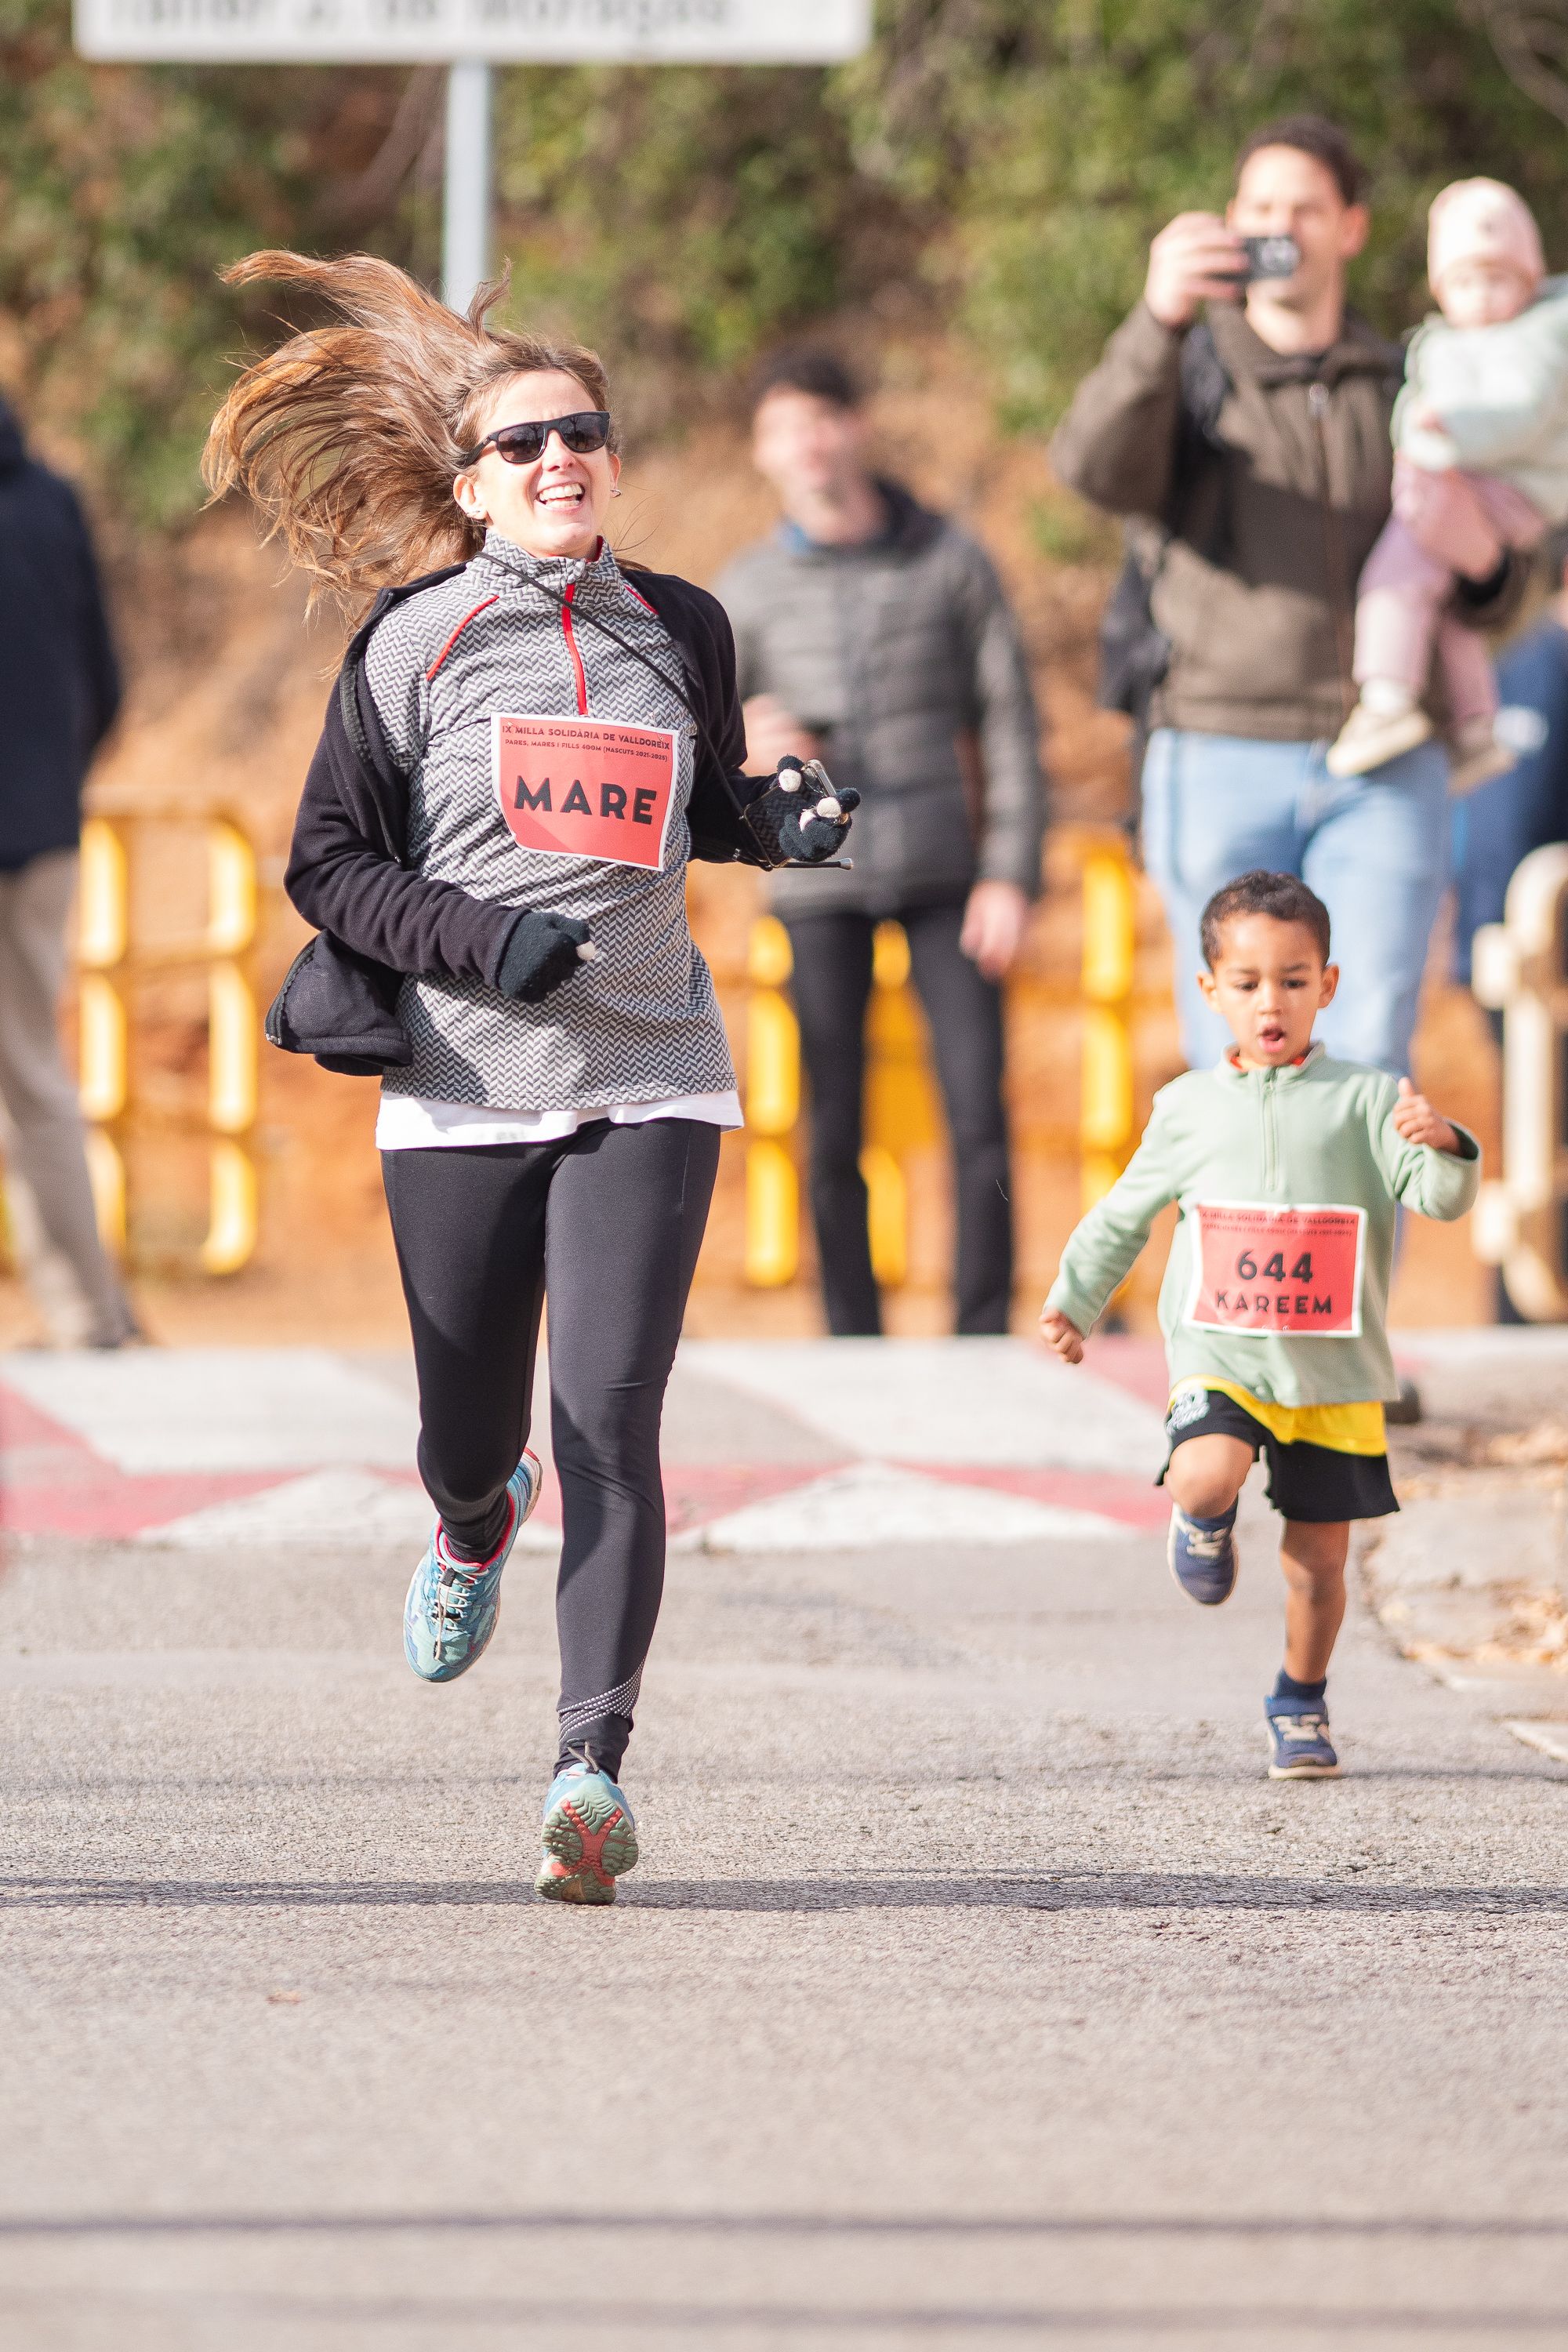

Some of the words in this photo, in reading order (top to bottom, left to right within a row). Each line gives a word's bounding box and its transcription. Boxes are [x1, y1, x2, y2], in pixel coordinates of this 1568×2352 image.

[503, 725, 512, 734] IX
[515, 727, 545, 735] MILLA
[548, 728, 599, 739] SOLIDÀRIA
[618, 735, 670, 750] VALLDOREIX
[604, 746, 633, 755] (NASCUTS
[636, 751, 668, 762] 2021-2025)
[514, 775, 657, 825] MARE
[1236, 1248, 1314, 1283] 644
[1218, 1291, 1332, 1315] KAREEM
